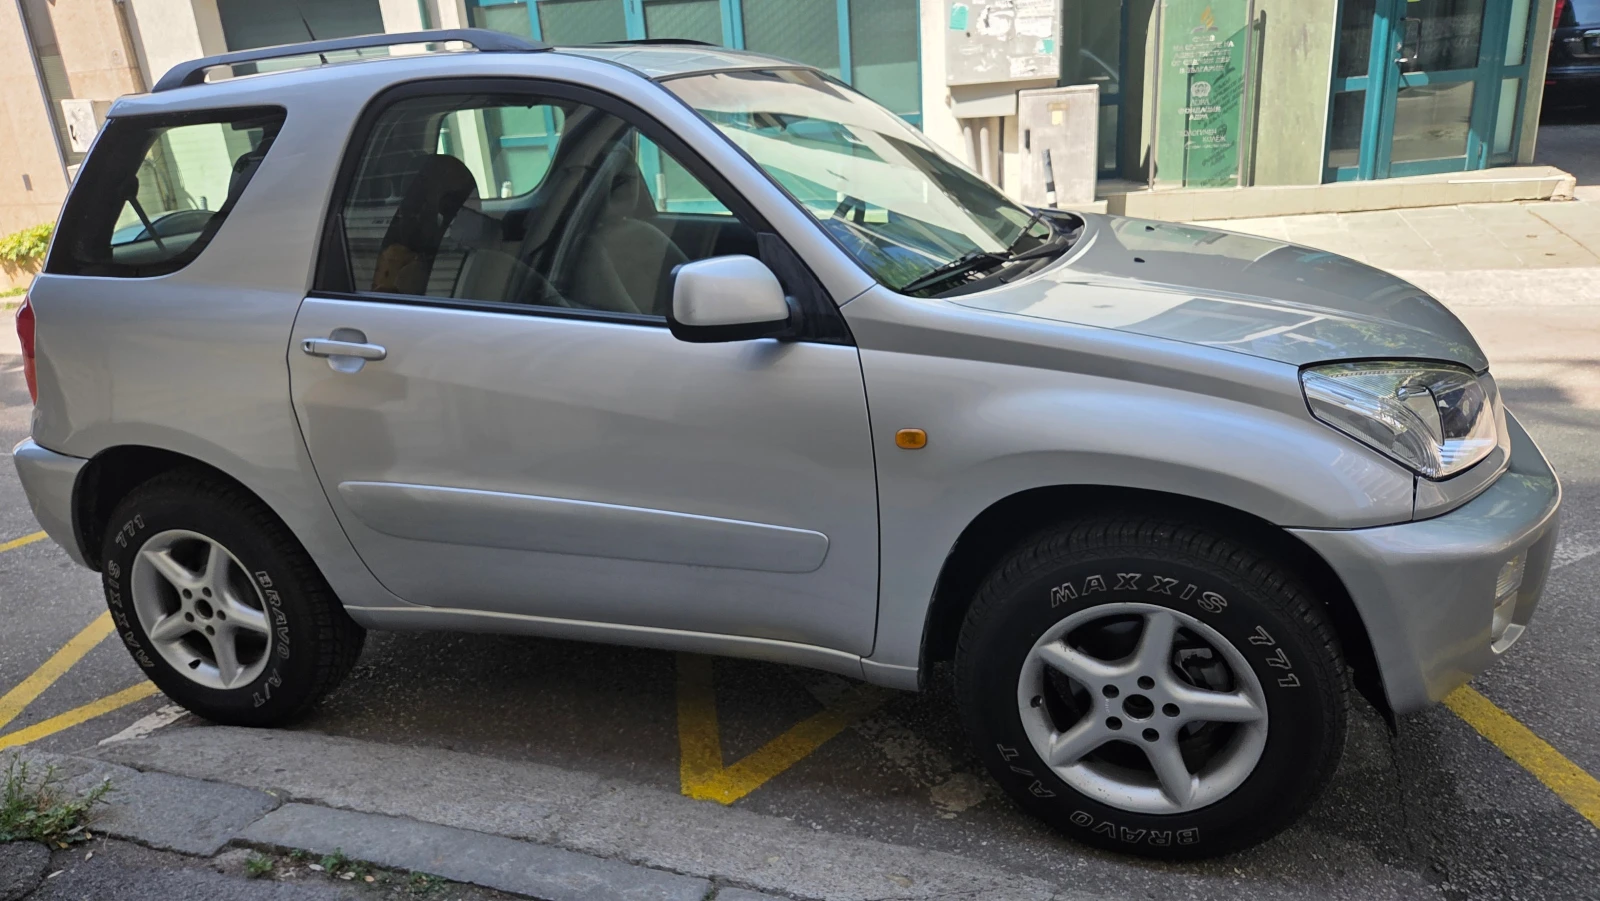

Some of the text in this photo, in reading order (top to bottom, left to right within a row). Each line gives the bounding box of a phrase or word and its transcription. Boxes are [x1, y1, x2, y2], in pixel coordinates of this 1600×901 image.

[107, 514, 155, 668] MAXXIS 771
[252, 571, 290, 708] BRAVO A/T
[1051, 572, 1302, 688] MAXXIS 771
[997, 743, 1201, 847] BRAVO A/T
